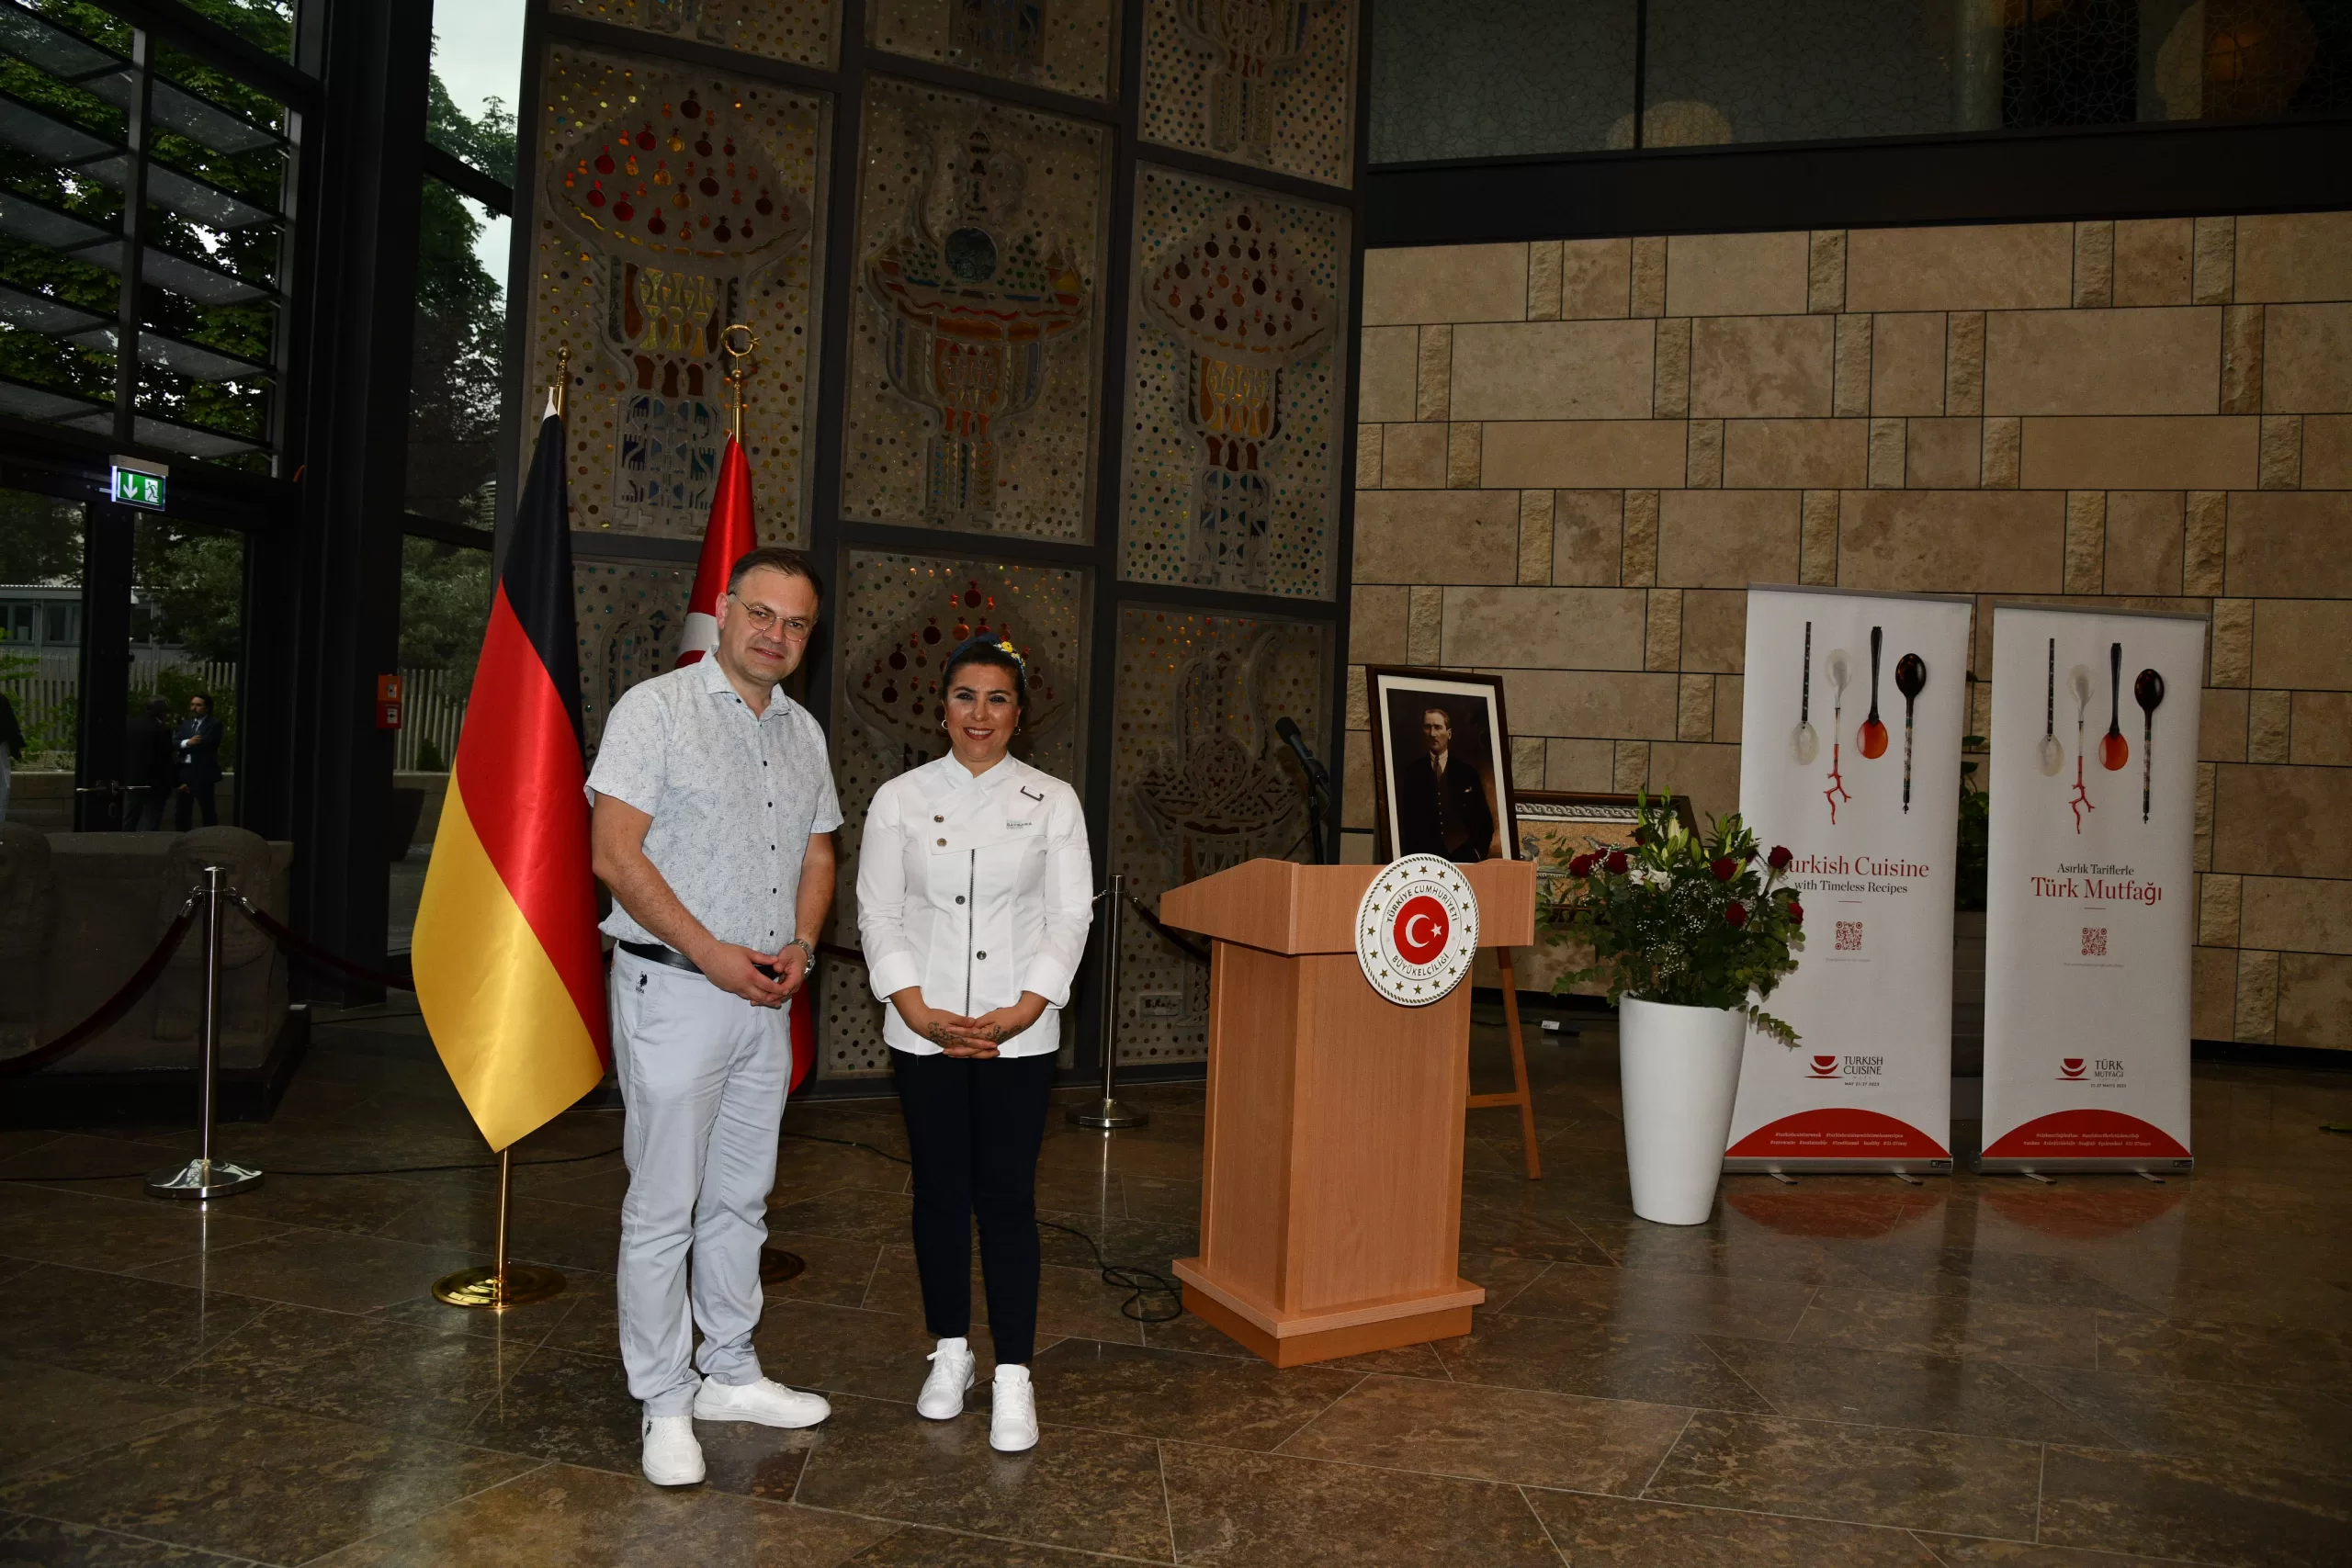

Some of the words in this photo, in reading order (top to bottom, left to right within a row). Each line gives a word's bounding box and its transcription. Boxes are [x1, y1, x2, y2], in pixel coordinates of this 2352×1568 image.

[1788, 854, 1849, 874] urkish
[1854, 856, 1929, 877] Cuisine
[2090, 863, 2134, 875] Tariflerle
[1794, 880, 1817, 890] with
[1819, 880, 1865, 892] Timeless
[1868, 882, 1908, 895] Recipes
[2030, 876, 2079, 897] Türk
[2084, 878, 2162, 906] Mutfağı
[1385, 888, 1412, 922] TÜRKİYE
[1414, 885, 1459, 921] CUMHURİYETİ
[1392, 952, 1450, 976] BÜYÜKELÇİLİĞİ
[1843, 1055, 1883, 1066] TURKISH
[2095, 1058, 2123, 1070] TÜRK
[1843, 1065, 1883, 1076] CUISINE
